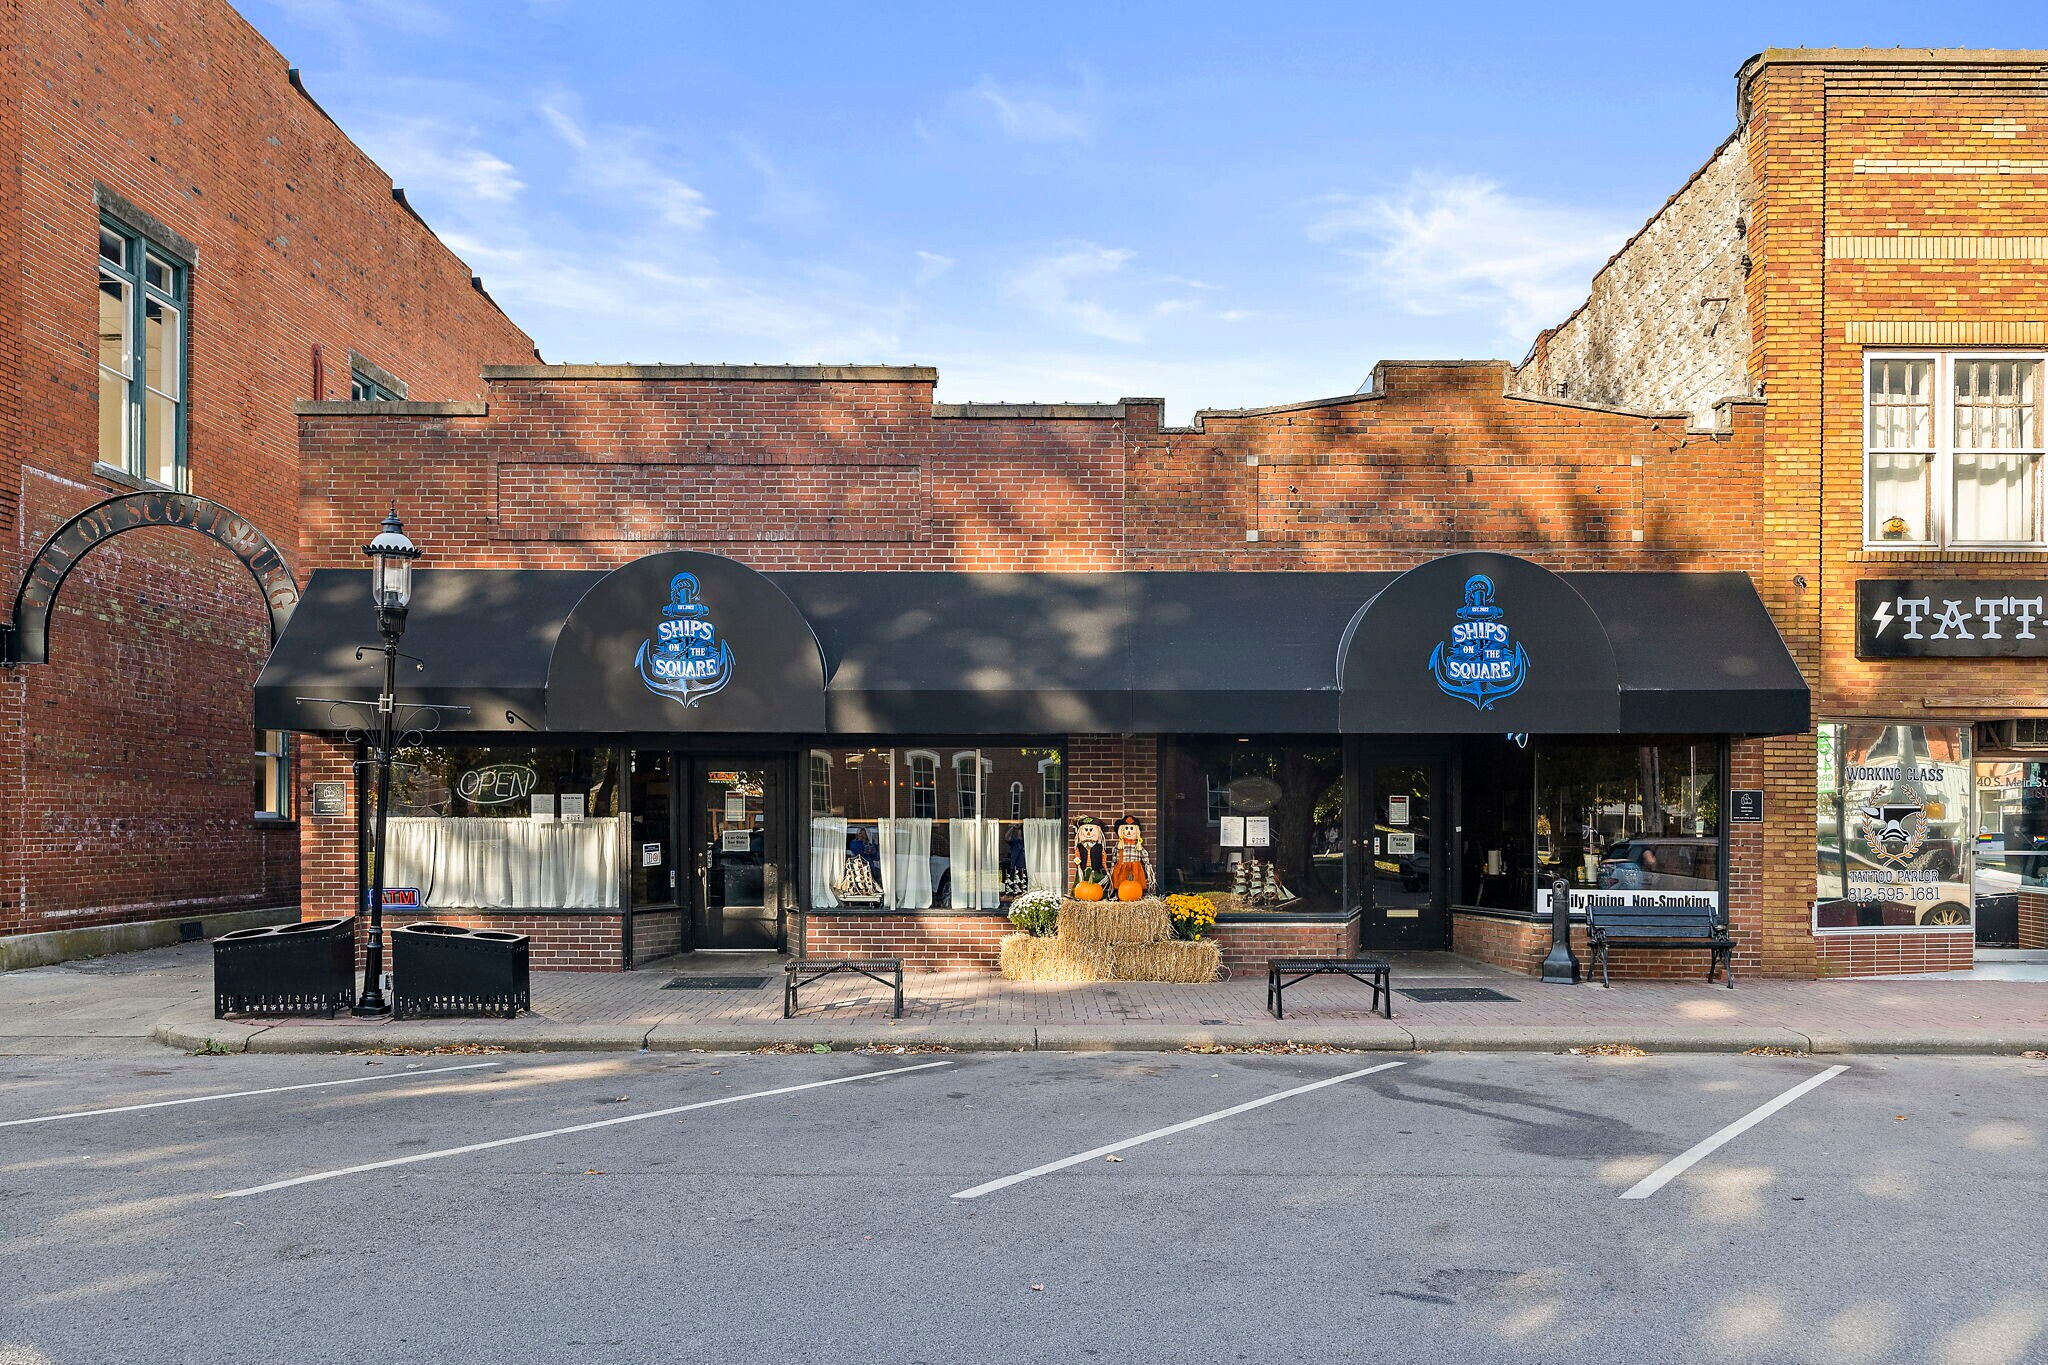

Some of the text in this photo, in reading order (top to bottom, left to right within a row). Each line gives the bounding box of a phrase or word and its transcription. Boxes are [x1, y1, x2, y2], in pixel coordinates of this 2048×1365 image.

[76, 503, 113, 543] OF
[123, 492, 297, 610] SCOTTSBURG
[1897, 595, 2048, 640] TATT
[658, 619, 714, 641] SHIPS
[1452, 621, 1509, 643] SHIPS
[668, 643, 706, 656] ON THE
[1462, 645, 1500, 658] ON THE
[655, 659, 717, 677] SQUARE
[1449, 660, 1512, 680] SQUARE
[1846, 767, 1944, 782] WORKING CLASS
[1976, 776, 1991, 787] 40
[460, 770, 530, 797] OPEN
[1849, 870, 1940, 883] TATTOO PARLOR
[1546, 894, 1585, 909] Fily
[1632, 894, 1710, 908] Non-Smoking
[1848, 886, 1940, 902] 812-595-1681
